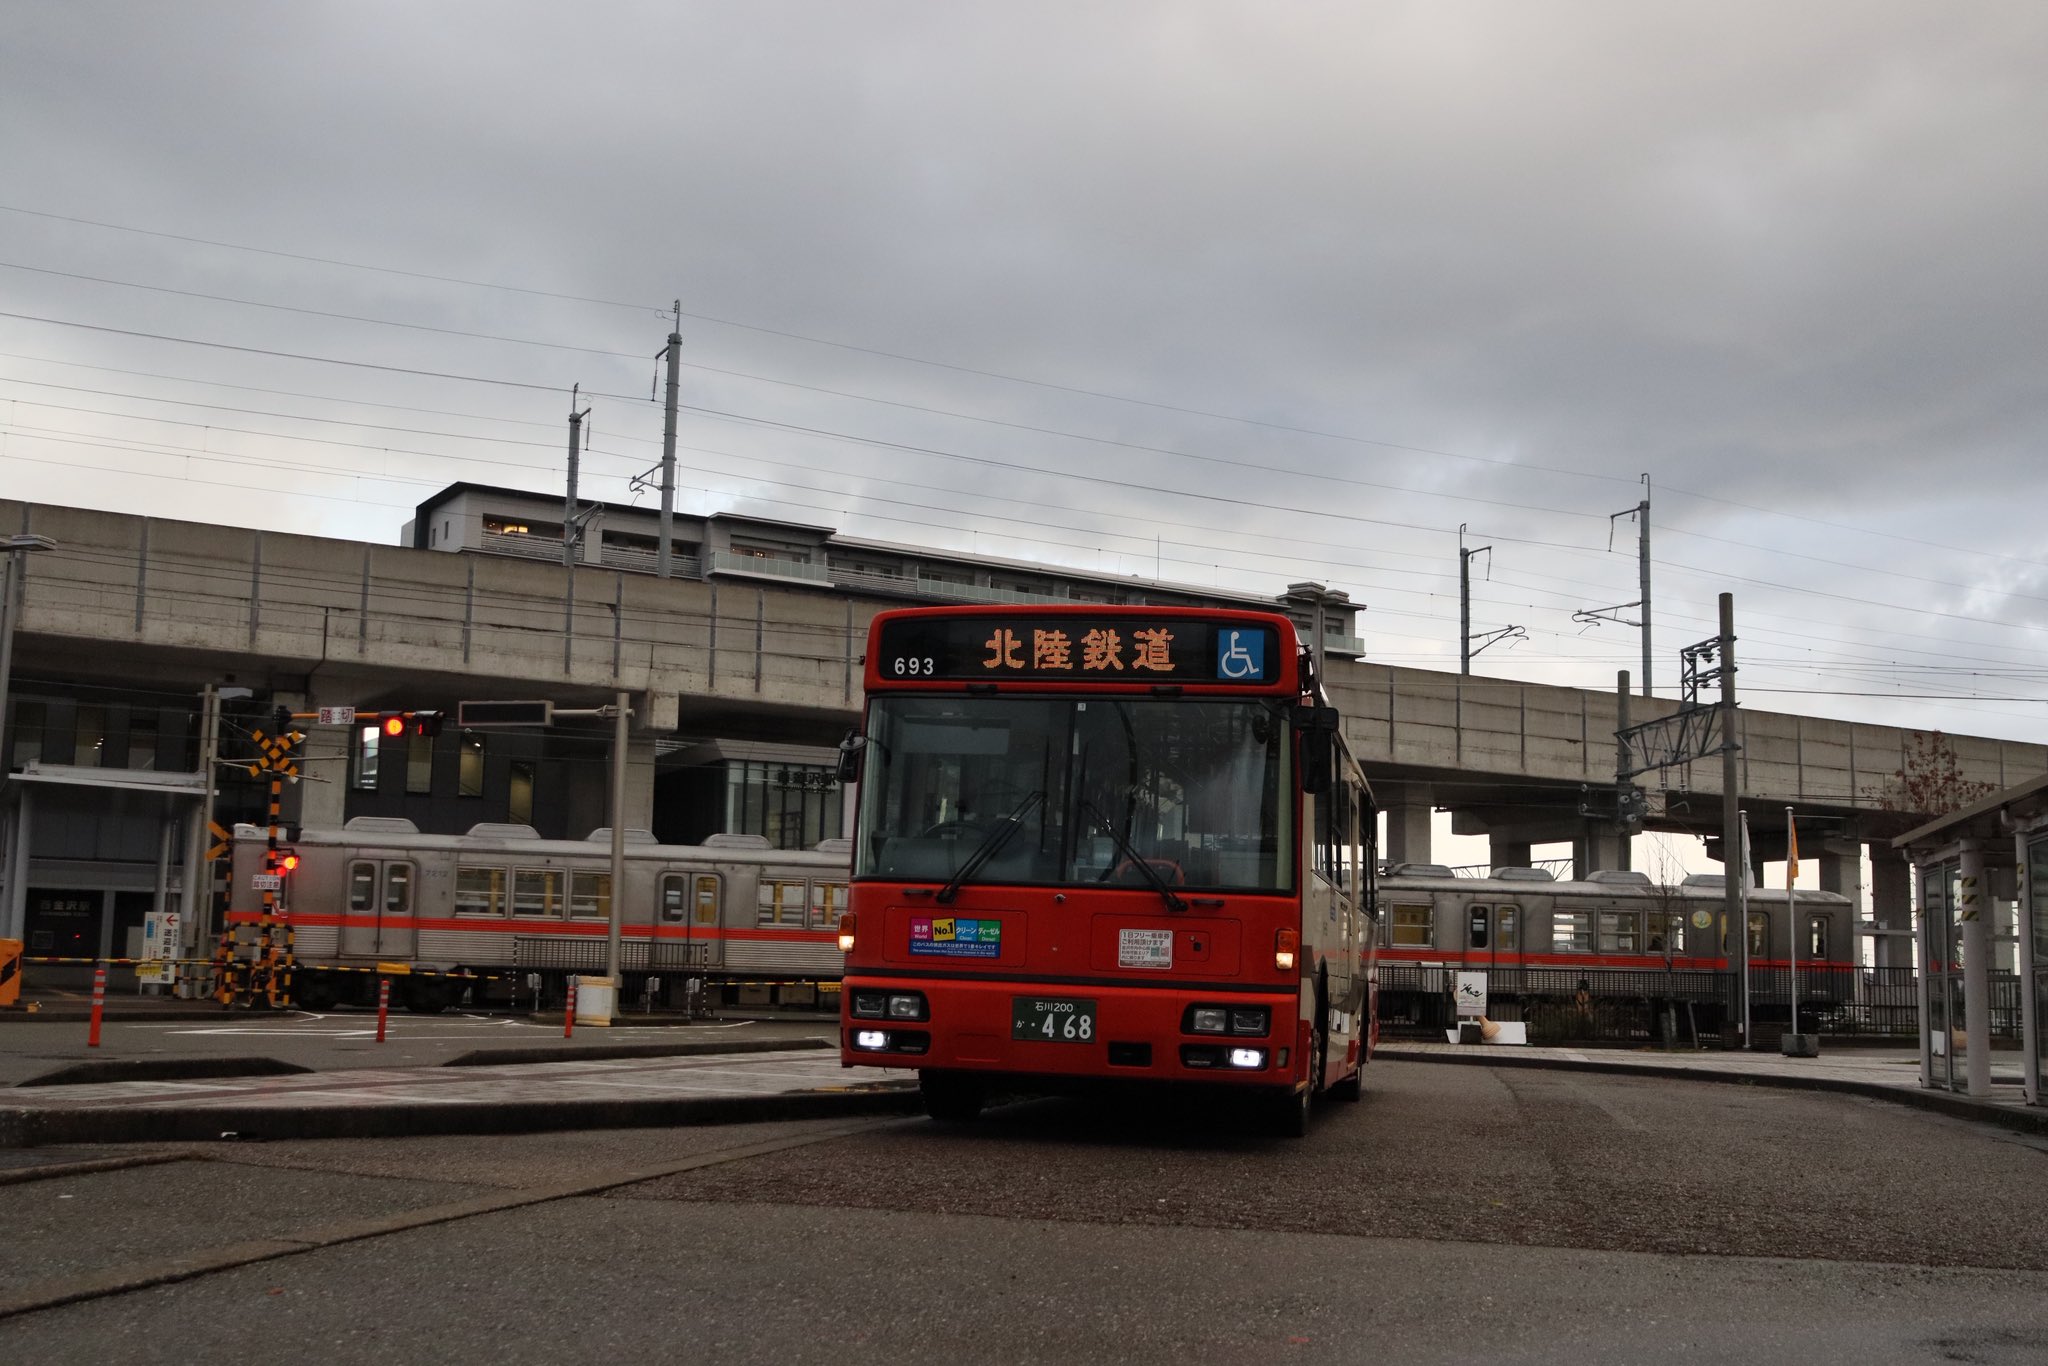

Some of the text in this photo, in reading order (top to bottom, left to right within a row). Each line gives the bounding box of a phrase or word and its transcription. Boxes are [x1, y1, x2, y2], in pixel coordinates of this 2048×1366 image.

[983, 628, 1176, 672] 北陸鉄道
[894, 657, 934, 675] 693
[320, 708, 353, 724] 踏切
[253, 881, 280, 889] 踏切注意
[914, 925, 929, 933] 世界
[934, 922, 954, 936] No.1
[978, 927, 1000, 935] ディーゼル
